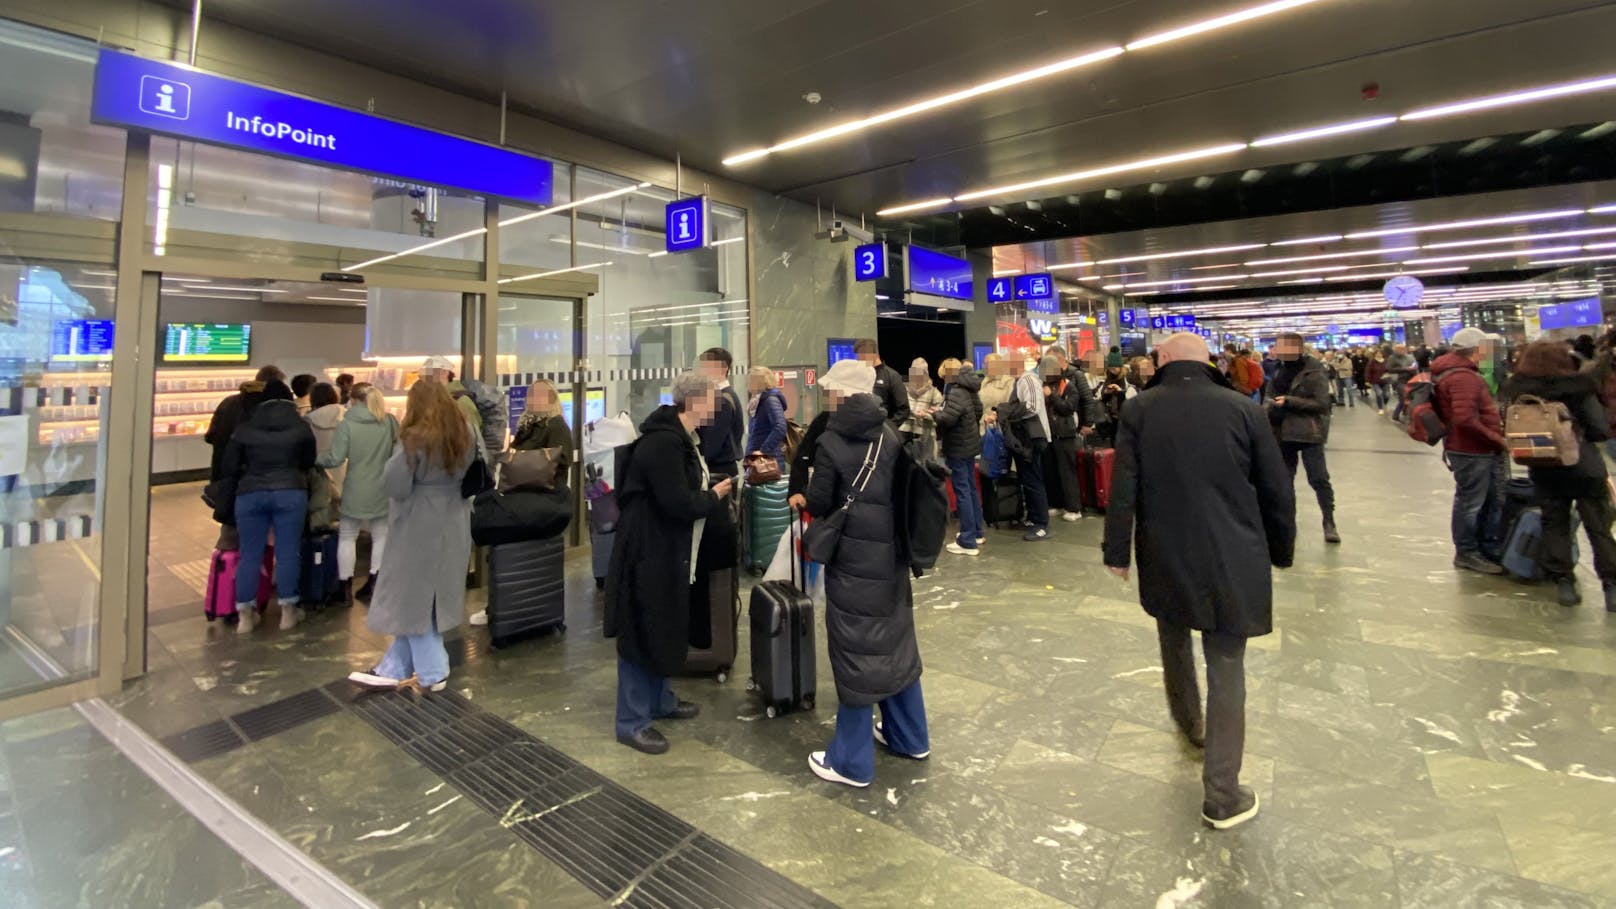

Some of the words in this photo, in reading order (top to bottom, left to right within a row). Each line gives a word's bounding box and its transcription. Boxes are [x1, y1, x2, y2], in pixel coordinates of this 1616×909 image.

[226, 111, 337, 151] InfoPoint
[862, 251, 876, 275] 3
[992, 281, 1006, 299] 4
[1123, 311, 1132, 322] 5
[1154, 318, 1162, 327] 6
